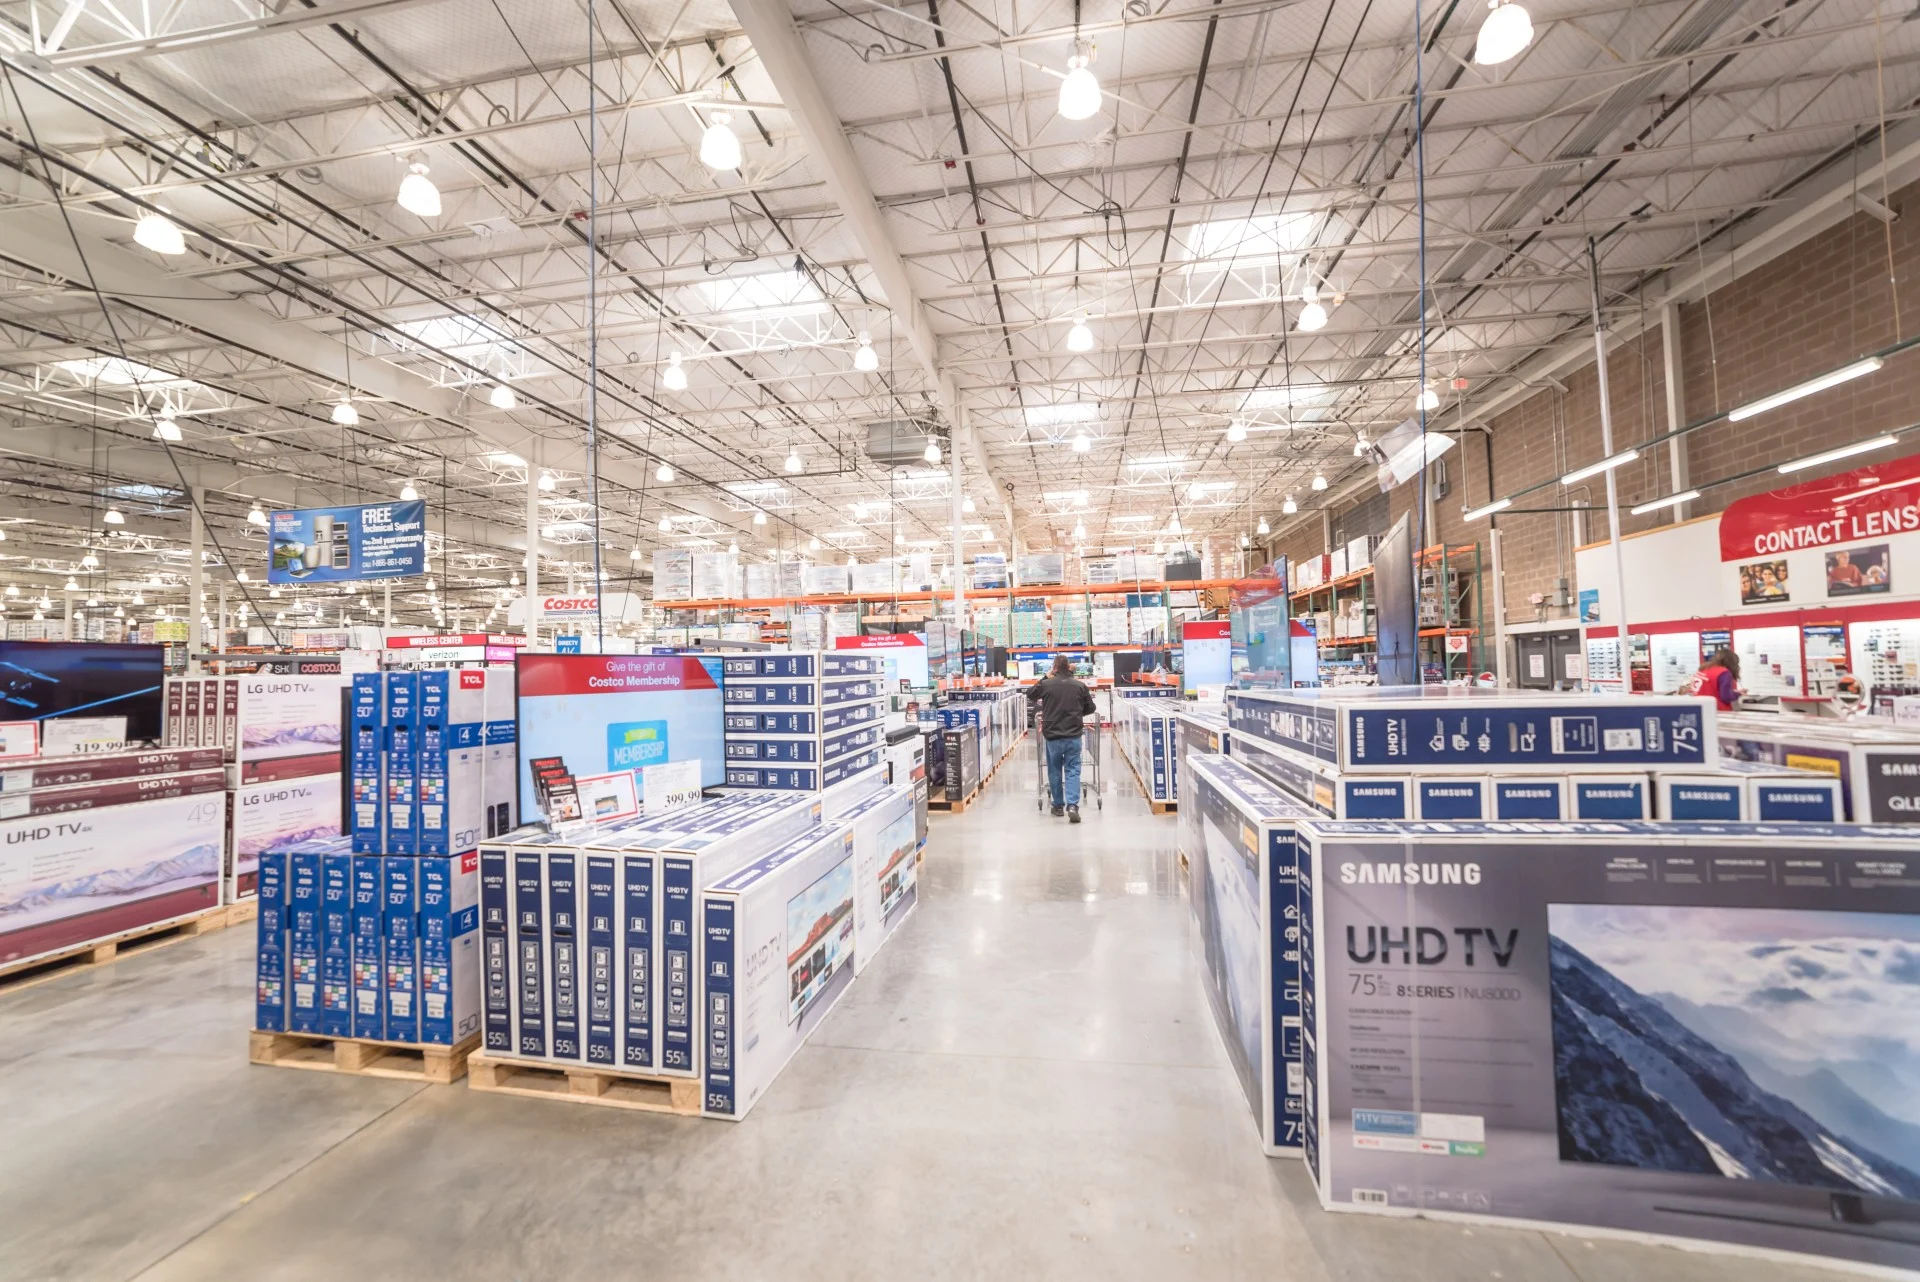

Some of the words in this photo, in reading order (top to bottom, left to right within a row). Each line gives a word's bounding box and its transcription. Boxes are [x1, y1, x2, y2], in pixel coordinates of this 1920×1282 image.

[362, 508, 392, 524] FREE
[362, 524, 393, 533] Technical
[395, 521, 420, 532] Support
[1754, 519, 1844, 554] CONTACT
[1852, 506, 1920, 538] LENS
[384, 538, 396, 546] year
[396, 535, 423, 544] warranty
[409, 637, 438, 645] WIRELESS
[439, 636, 463, 644] CENTER
[488, 636, 514, 644] WIRELESS
[428, 651, 459, 659] verizon
[606, 662, 625, 672] Give
[628, 662, 642, 671] the
[643, 662, 656, 674] gift
[657, 661, 665, 670] of
[463, 676, 482, 684] TCL
[589, 676, 624, 687] Costco
[626, 674, 680, 686] Membership
[248, 685, 263, 694] LG
[268, 684, 291, 693] UHD
[294, 684, 308, 693] TV
[1356, 717, 1365, 758] SAMSUNG
[72, 742, 123, 754] 319.99
[614, 740, 664, 766] MEMBERSHIP
[138, 754, 158, 764] UHD
[160, 754, 173, 762] TV
[139, 780, 159, 790] UHD
[161, 779, 174, 788] TV
[243, 796, 260, 806] LG
[264, 793, 286, 804] UHD
[290, 788, 305, 799] TV
[1353, 788, 1396, 796] SAMSUNG
[1428, 788, 1473, 797] SAMSUNG
[1505, 789, 1551, 798] SAMSUNG
[1585, 789, 1633, 798] SAMSUNG
[1679, 791, 1731, 801] SAMSUNG
[665, 790, 700, 808] 399.99
[1768, 793, 1823, 803] SAMSUNG
[6, 828, 50, 845] UHD
[56, 822, 82, 837] TV
[464, 858, 478, 867] TC
[1340, 863, 1481, 885] SAMSUNG
[464, 912, 472, 924] 4
[1407, 986, 1454, 998] SERIES
